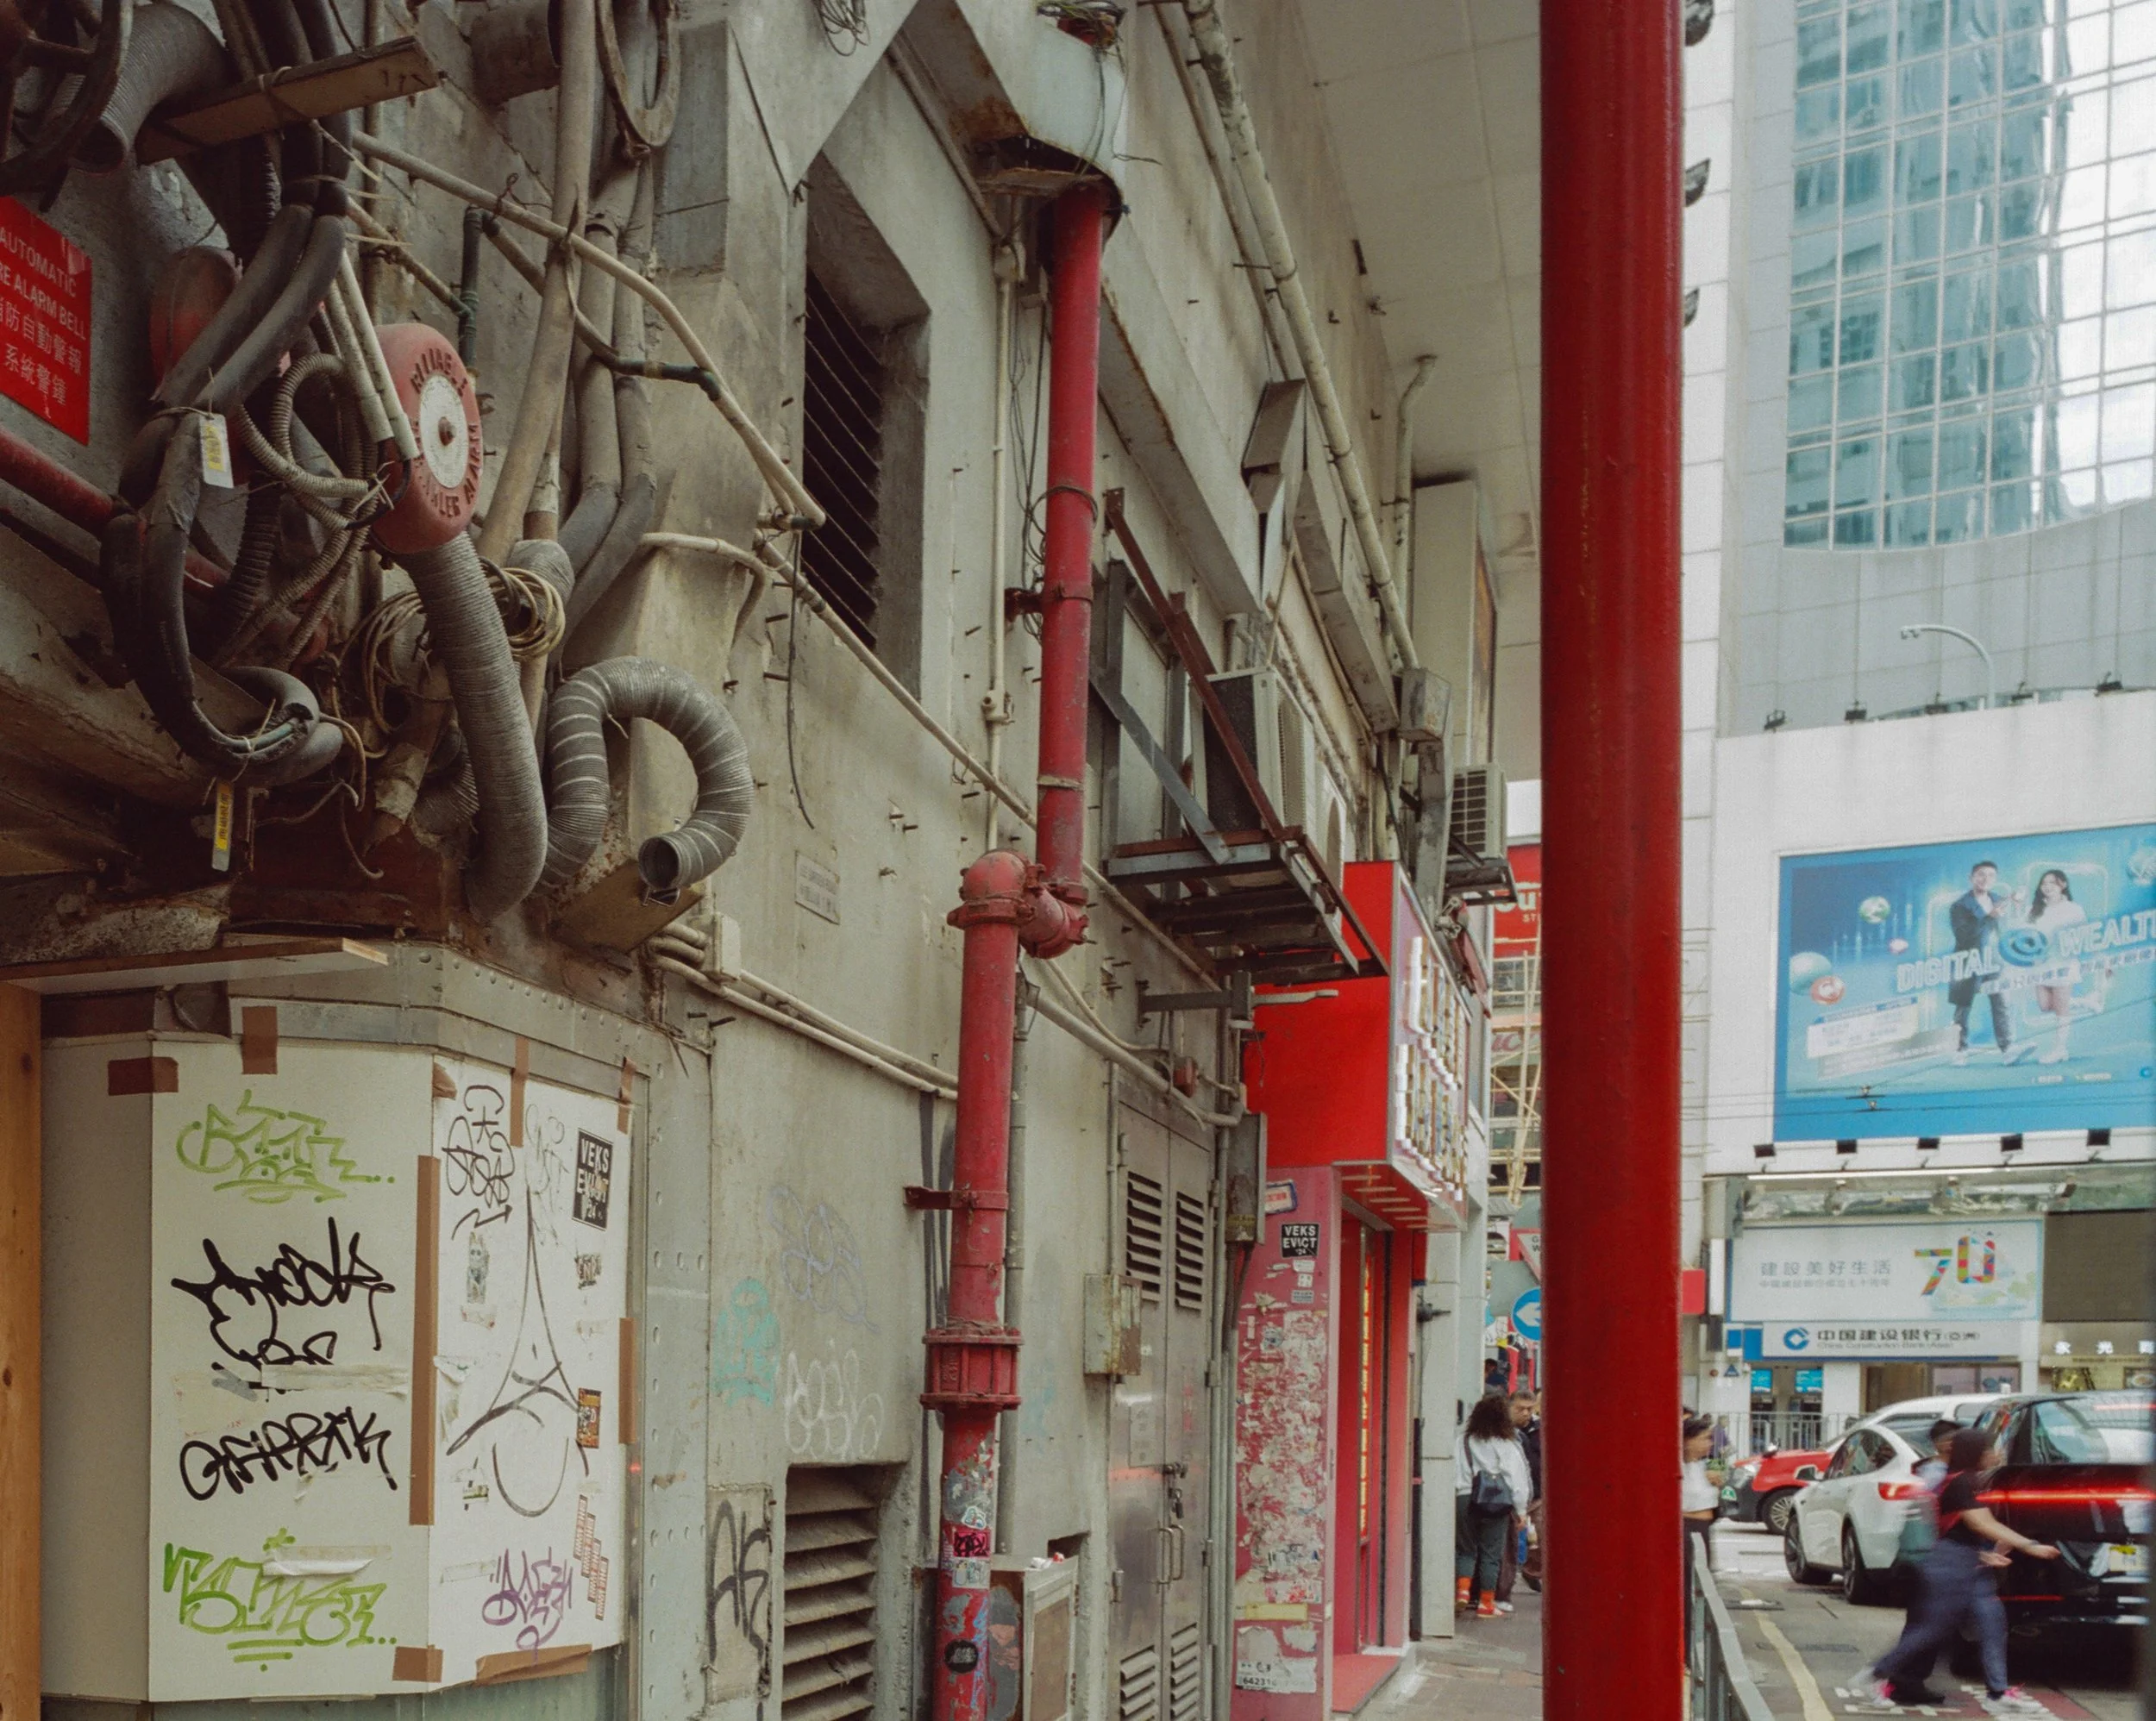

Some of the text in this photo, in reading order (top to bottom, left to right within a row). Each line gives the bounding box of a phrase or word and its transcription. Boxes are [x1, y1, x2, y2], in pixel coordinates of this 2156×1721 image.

[14, 273, 57, 319] ALARM
[60, 304, 86, 341] BELL
[1897, 946, 2002, 993] DIGITAL
[580, 1138, 610, 1173] VEKS
[1282, 1237, 1317, 1249] EVICT
[1284, 1225, 1316, 1236] VEKS
